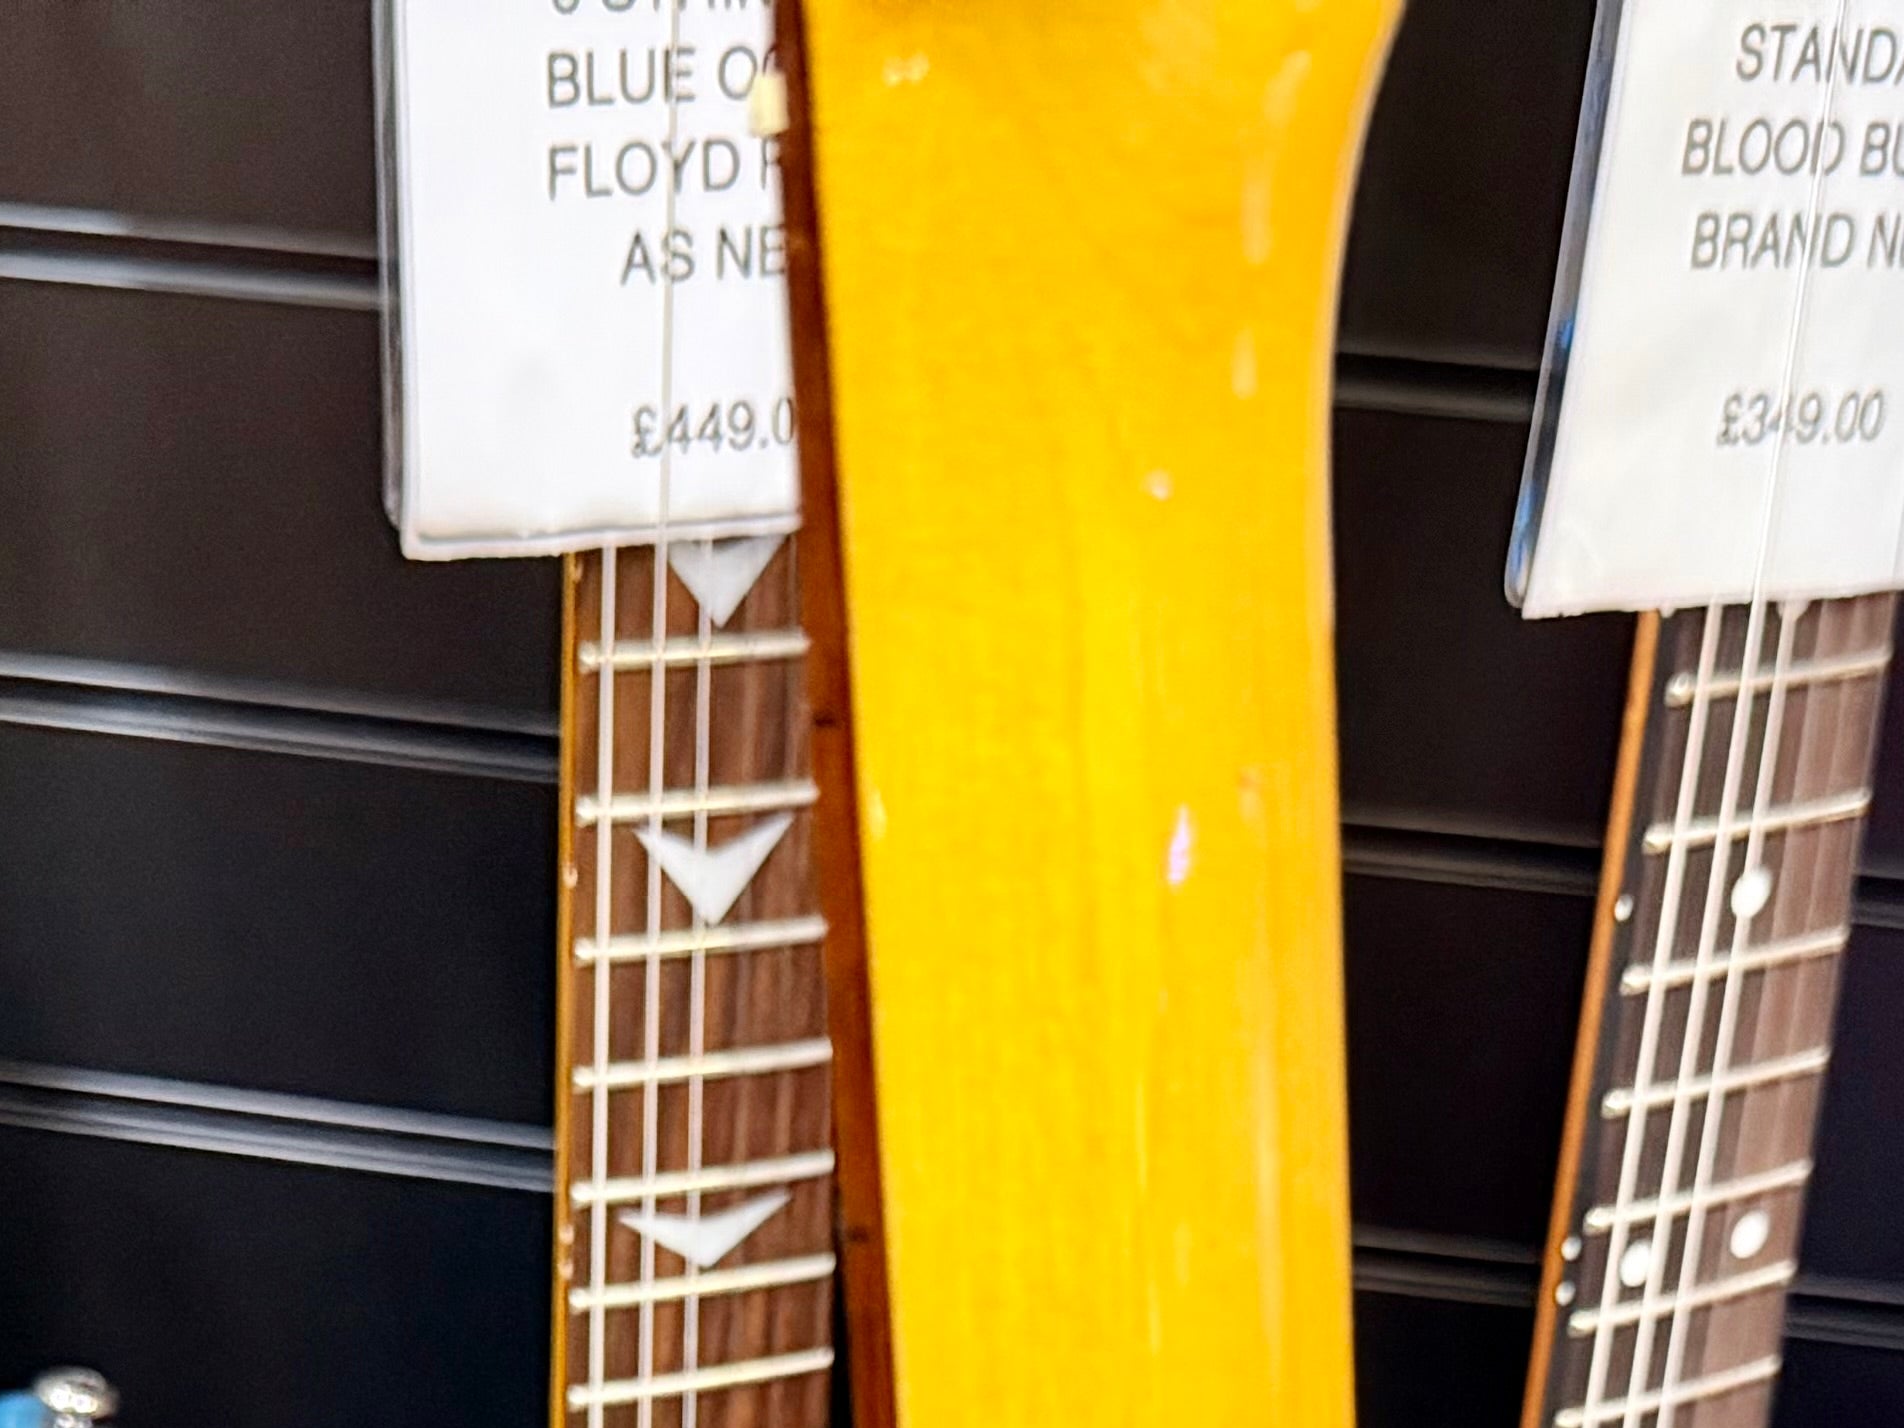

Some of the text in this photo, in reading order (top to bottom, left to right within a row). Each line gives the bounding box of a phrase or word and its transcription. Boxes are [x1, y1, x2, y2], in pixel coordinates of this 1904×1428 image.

[548, 47, 696, 108] BLUE
[548, 138, 741, 201] FLOYD
[1681, 117, 1844, 177] BLOOD
[620, 224, 788, 286] AS NE
[1690, 210, 1856, 270] BRAND
[630, 398, 795, 459] £449.0
